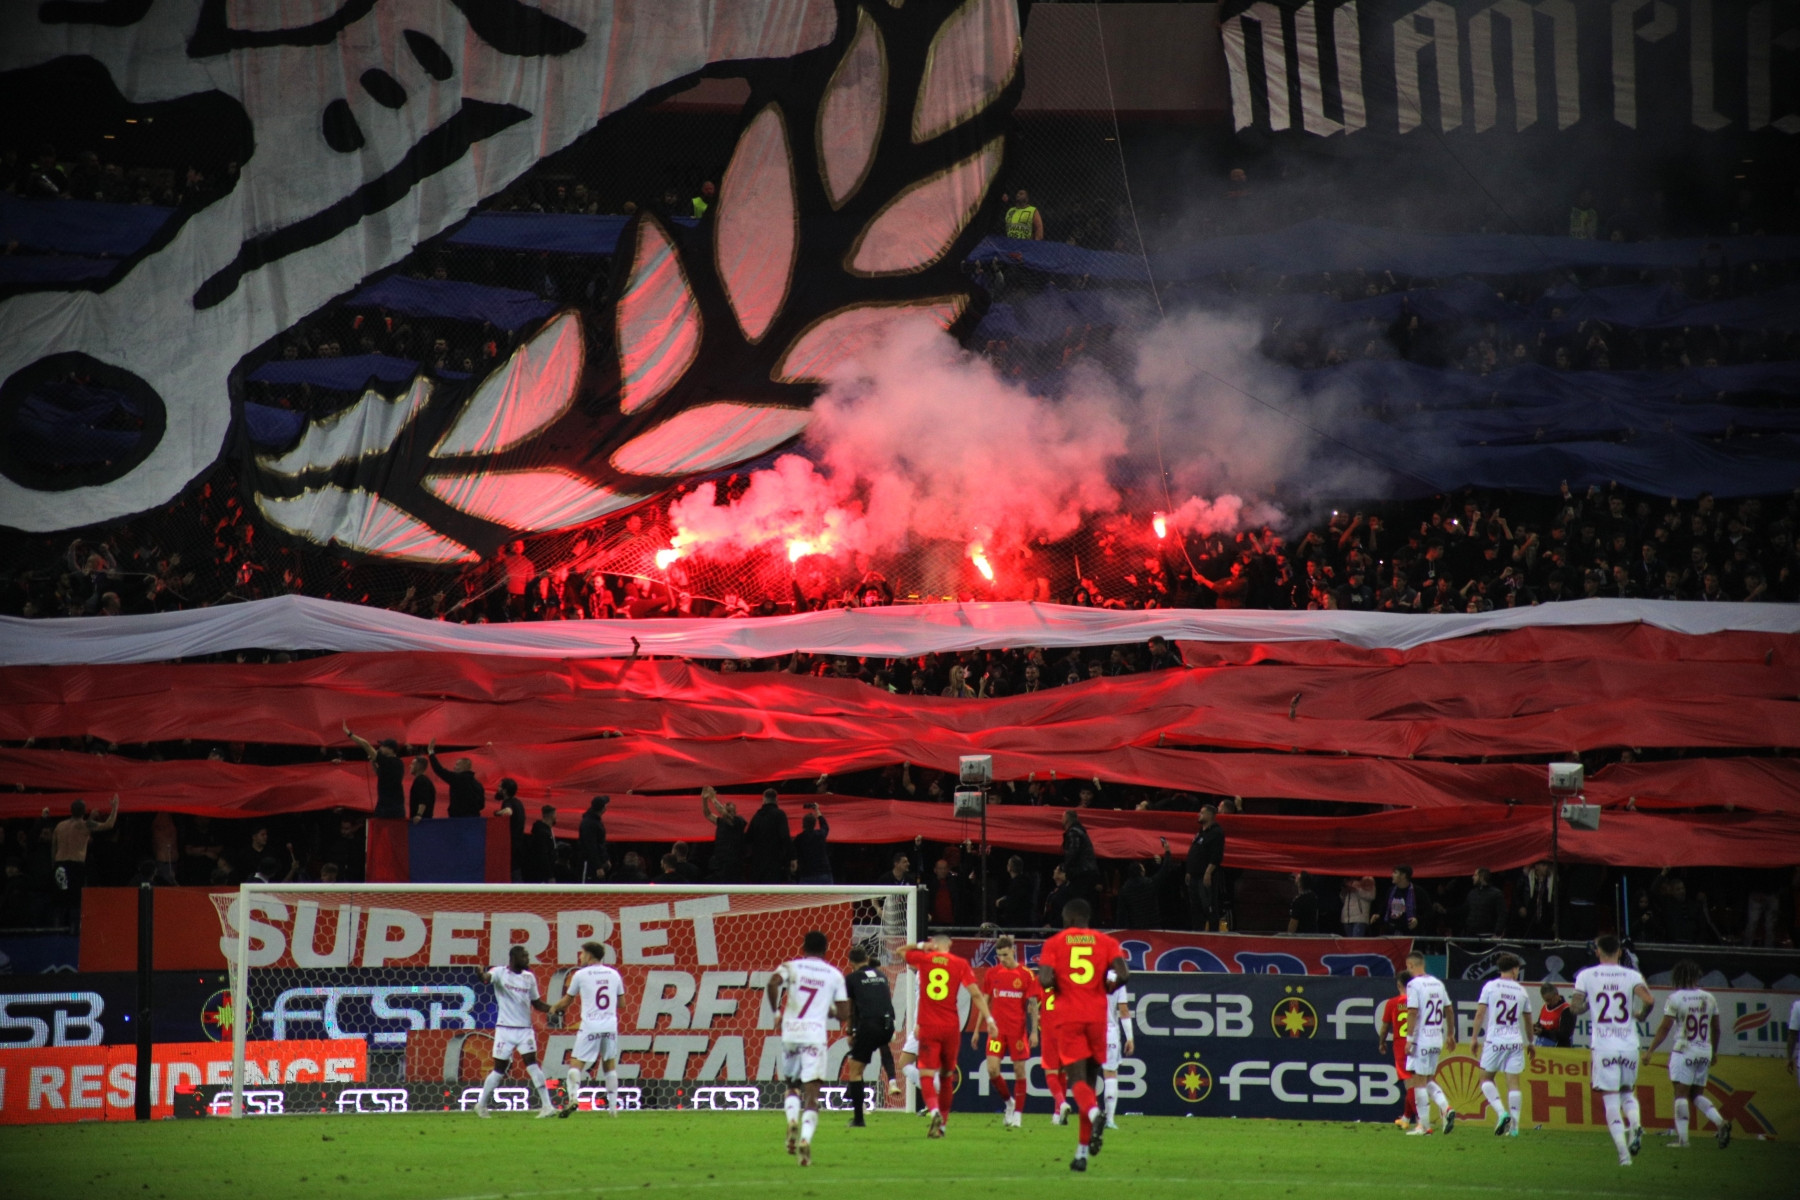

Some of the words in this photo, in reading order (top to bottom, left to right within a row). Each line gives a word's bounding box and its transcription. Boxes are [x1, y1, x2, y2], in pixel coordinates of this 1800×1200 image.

[220, 894, 731, 968] SUPERBET
[1069, 945, 1095, 985] 5
[595, 986, 610, 1010] 6
[926, 968, 950, 1000] 8
[262, 986, 475, 1043] FCSB
[798, 985, 818, 1019] 7
[1425, 1000, 1443, 1026] 26
[1496, 1000, 1518, 1026] 24
[1595, 992, 1629, 1024] 23
[1685, 1014, 1709, 1041] 96
[989, 1039, 1002, 1053] 10
[1530, 1058, 1594, 1077] Shel
[1220, 1061, 1400, 1105] FCSB
[335, 1088, 408, 1113] FCSB
[691, 1086, 760, 1110] FCSB
[1528, 1079, 1767, 1135] HLX
